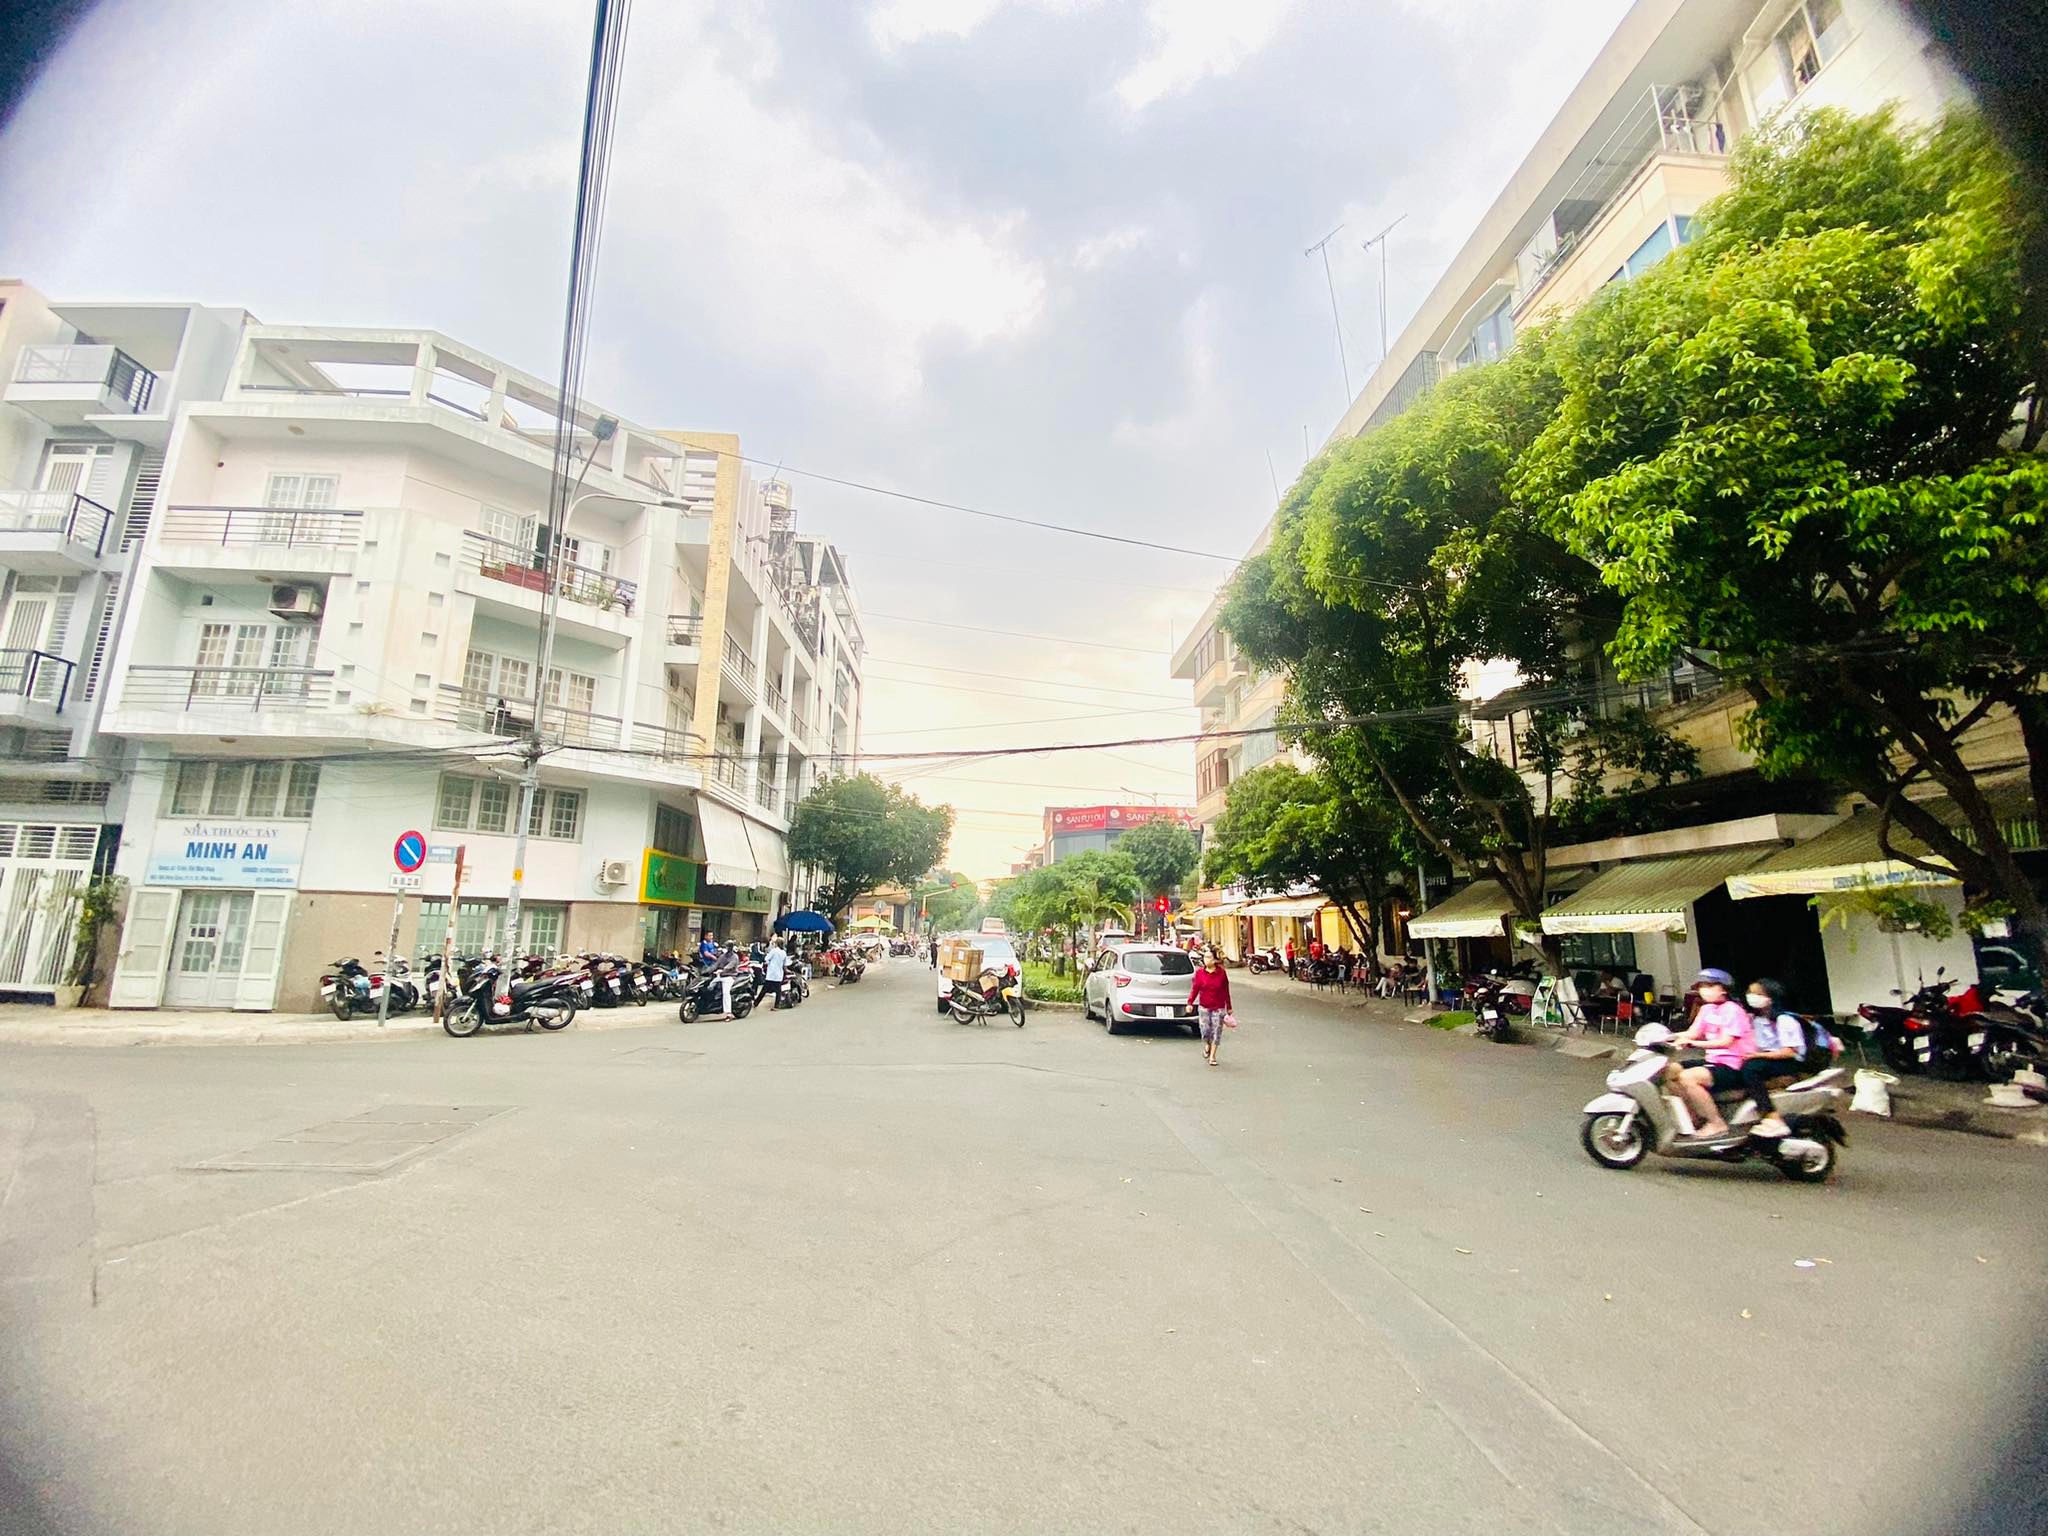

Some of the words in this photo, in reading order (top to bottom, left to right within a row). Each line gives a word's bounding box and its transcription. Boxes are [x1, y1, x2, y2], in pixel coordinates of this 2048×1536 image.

[1066, 815, 1080, 824] SAN
[1126, 813, 1144, 821] SAN
[186, 842, 237, 859] MINH
[241, 843, 268, 860] AN
